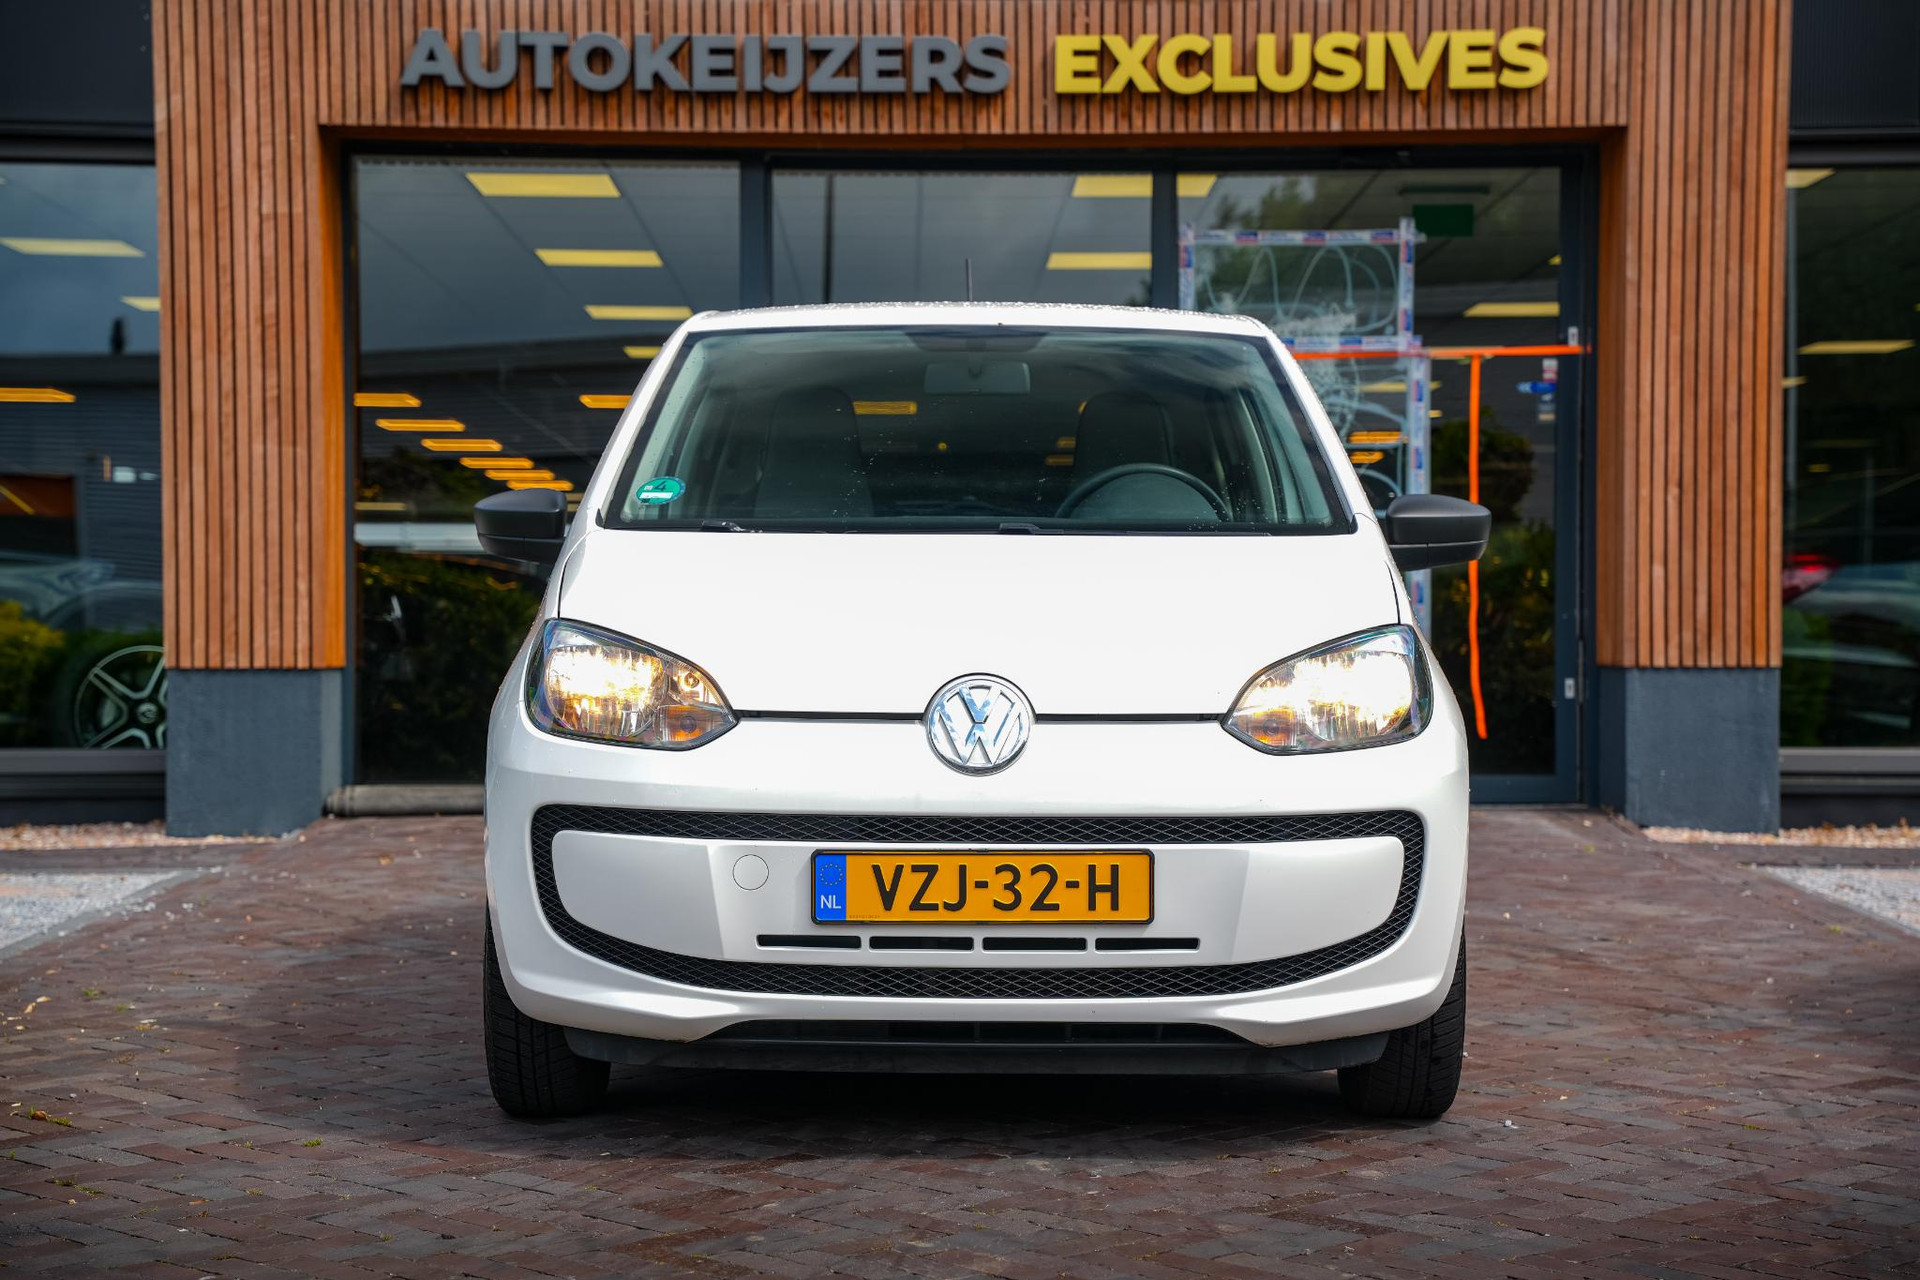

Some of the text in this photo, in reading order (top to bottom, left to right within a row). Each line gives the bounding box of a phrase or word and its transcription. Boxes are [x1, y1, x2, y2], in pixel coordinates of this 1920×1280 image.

[401, 27, 1549, 94] AUTOKEIJZERS EXCLUSIVES
[654, 480, 668, 491] 4
[928, 678, 1031, 768] VW
[820, 894, 842, 909] NL
[871, 864, 1120, 911] VZJ-32-H
